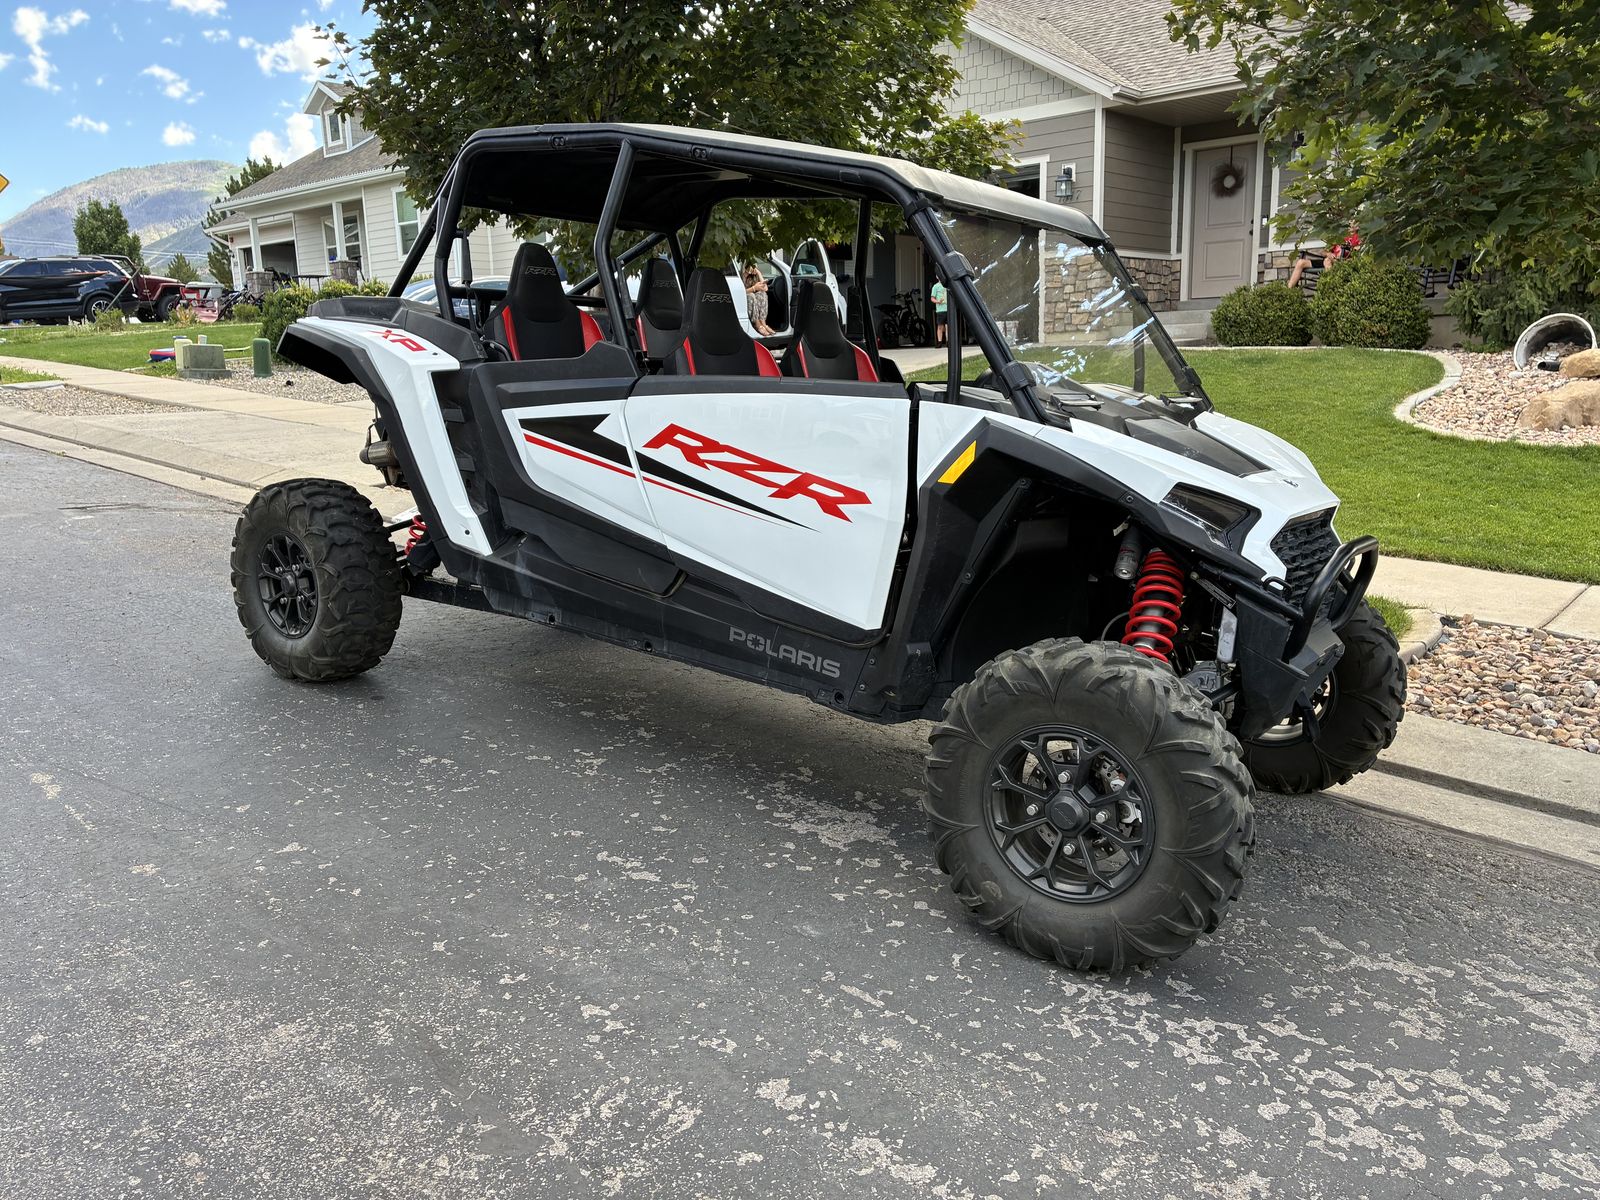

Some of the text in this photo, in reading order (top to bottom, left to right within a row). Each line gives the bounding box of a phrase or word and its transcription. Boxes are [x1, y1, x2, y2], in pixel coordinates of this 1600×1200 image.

[525, 265, 556, 275] RZR
[702, 293, 732, 303] RZR
[376, 329, 428, 352] XP
[642, 423, 872, 523] RZR
[728, 626, 841, 679] POLARIS
